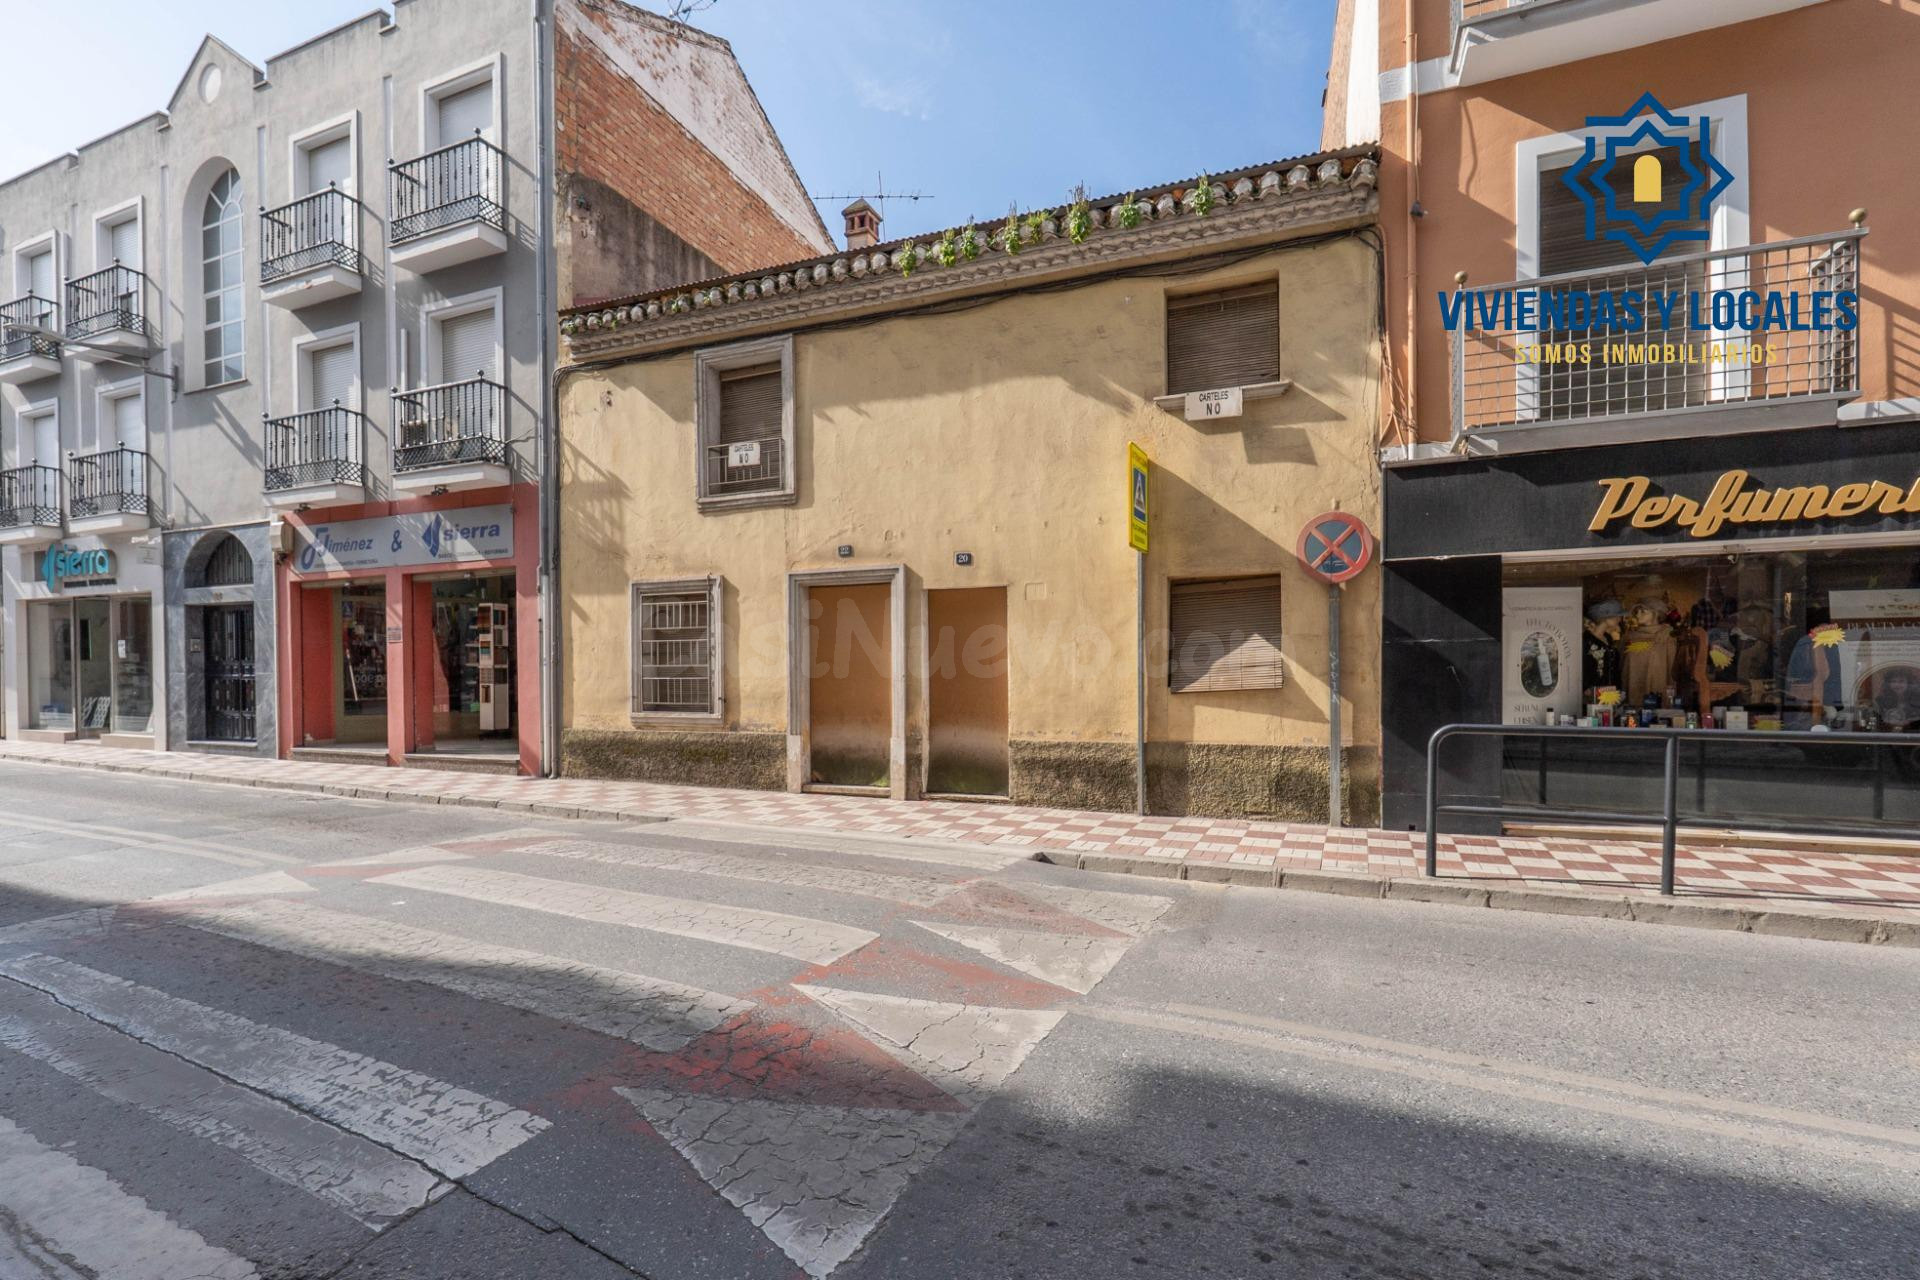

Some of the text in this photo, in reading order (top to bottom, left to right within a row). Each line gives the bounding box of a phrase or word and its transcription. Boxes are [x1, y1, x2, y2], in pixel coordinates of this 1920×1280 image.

[1199, 390, 1229, 402] CARTELES
[1206, 402, 1221, 416] NO
[391, 529, 403, 552] &
[55, 544, 109, 577] sierra
